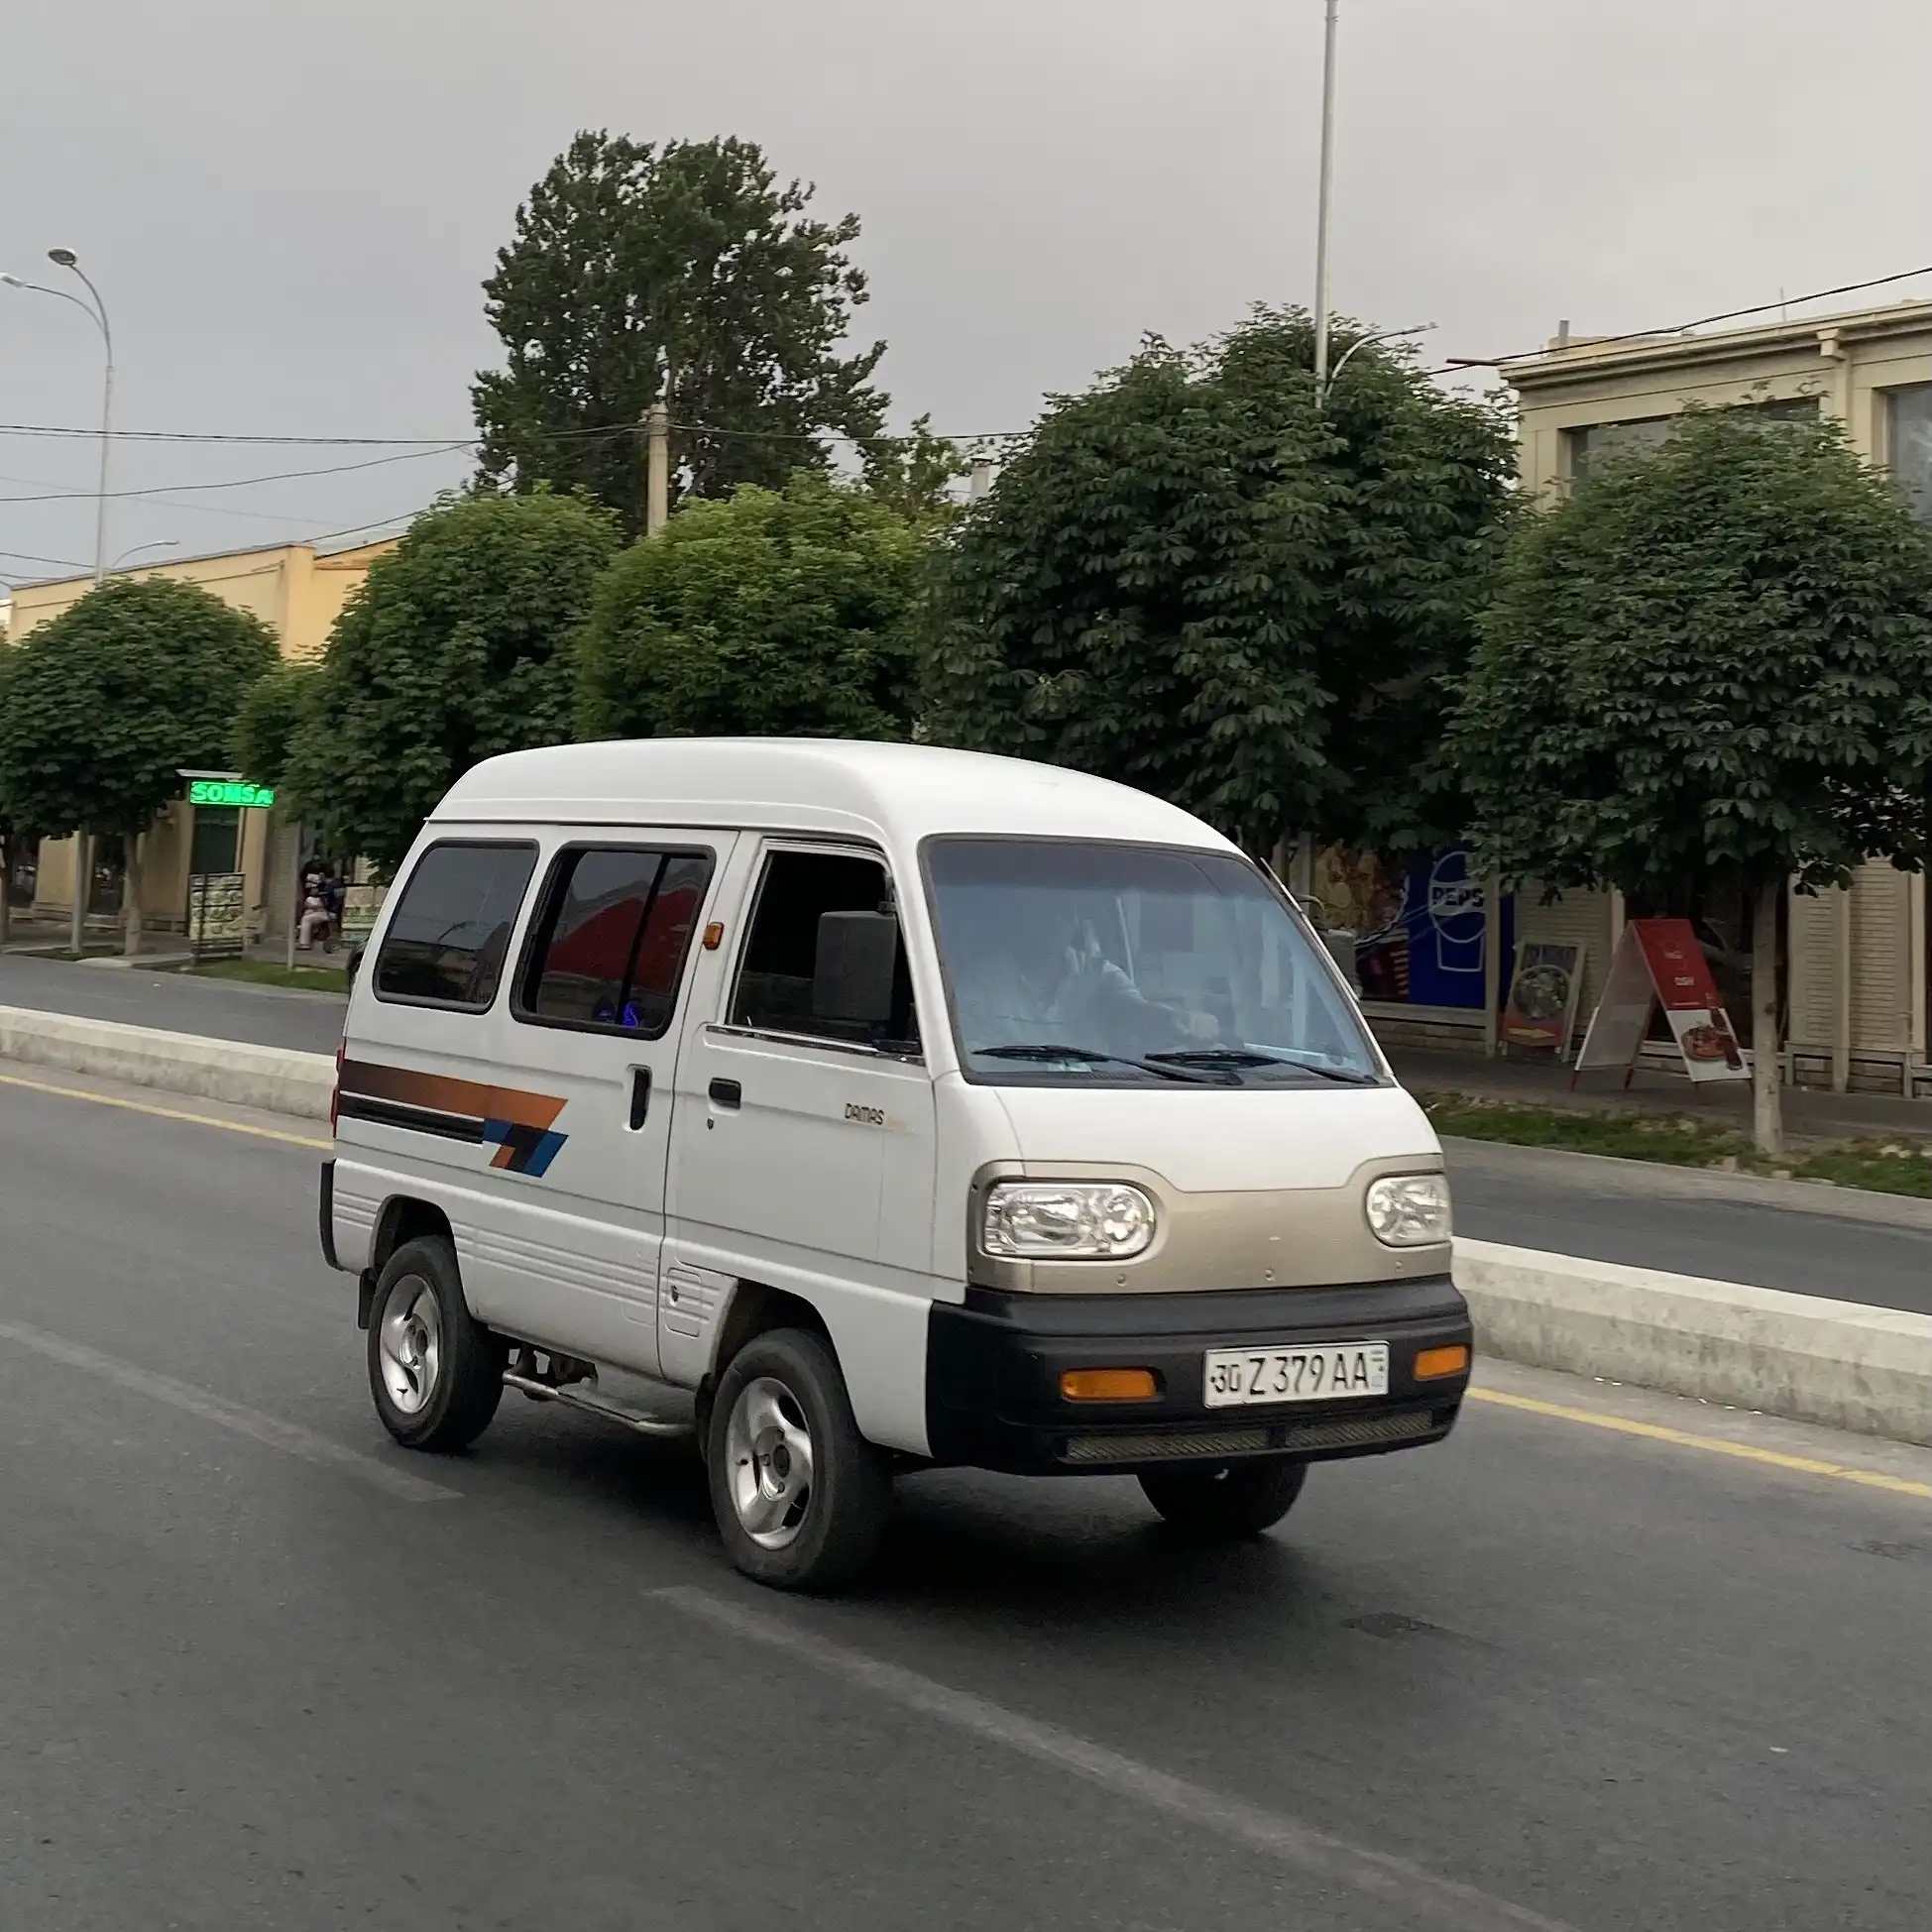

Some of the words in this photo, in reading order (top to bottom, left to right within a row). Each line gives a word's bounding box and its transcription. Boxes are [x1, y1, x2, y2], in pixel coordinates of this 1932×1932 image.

[191, 783, 273, 804] SOMSA
[1432, 887, 1484, 907] PEPS
[1214, 1364, 1241, 1393] 30
[1249, 1357, 1267, 1395] Z
[1273, 1354, 1325, 1393] 379
[1331, 1352, 1370, 1391] AA
